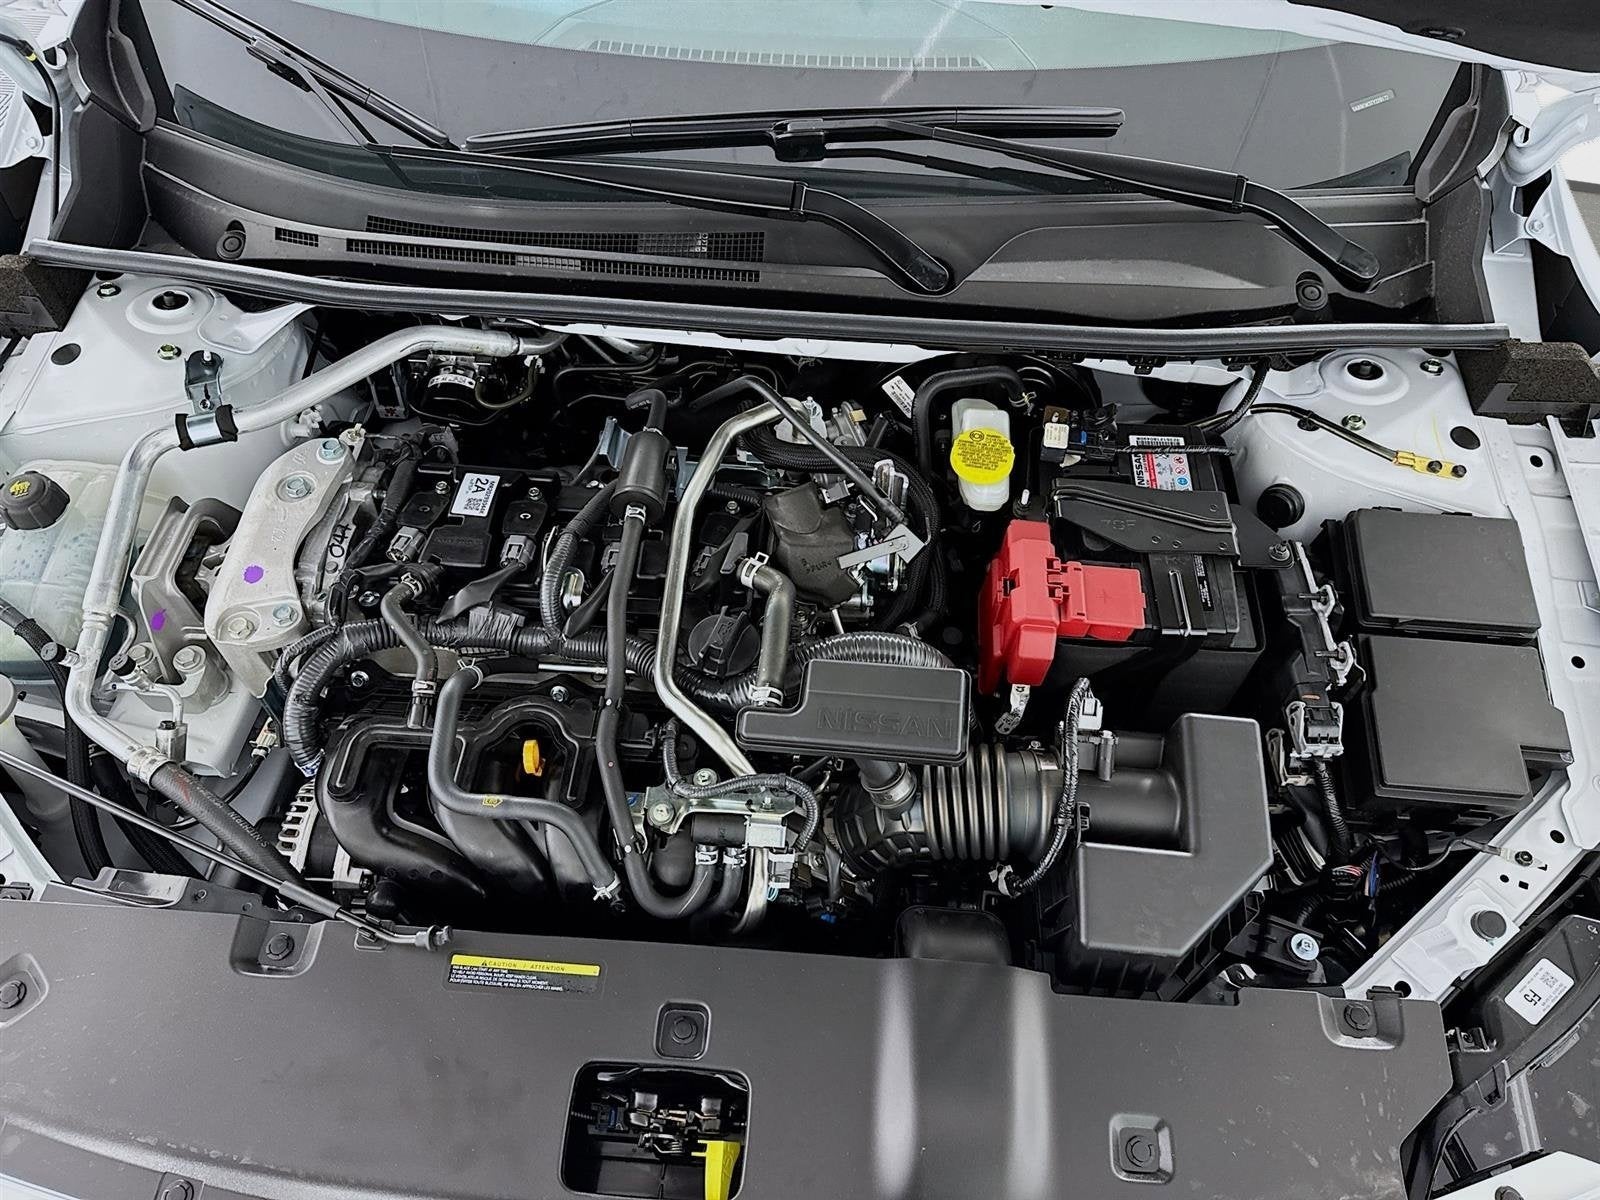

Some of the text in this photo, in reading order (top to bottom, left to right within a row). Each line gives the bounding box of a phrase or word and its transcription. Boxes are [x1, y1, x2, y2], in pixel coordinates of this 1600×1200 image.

[471, 477, 490, 493] 2A
[519, 512, 532, 520] C
[816, 707, 951, 738] NISSAN
[227, 811, 264, 841] NICHIRIN
[488, 960, 518, 968] CAUTION
[530, 963, 566, 972] ATTENTION
[1523, 988, 1542, 1006] F5
